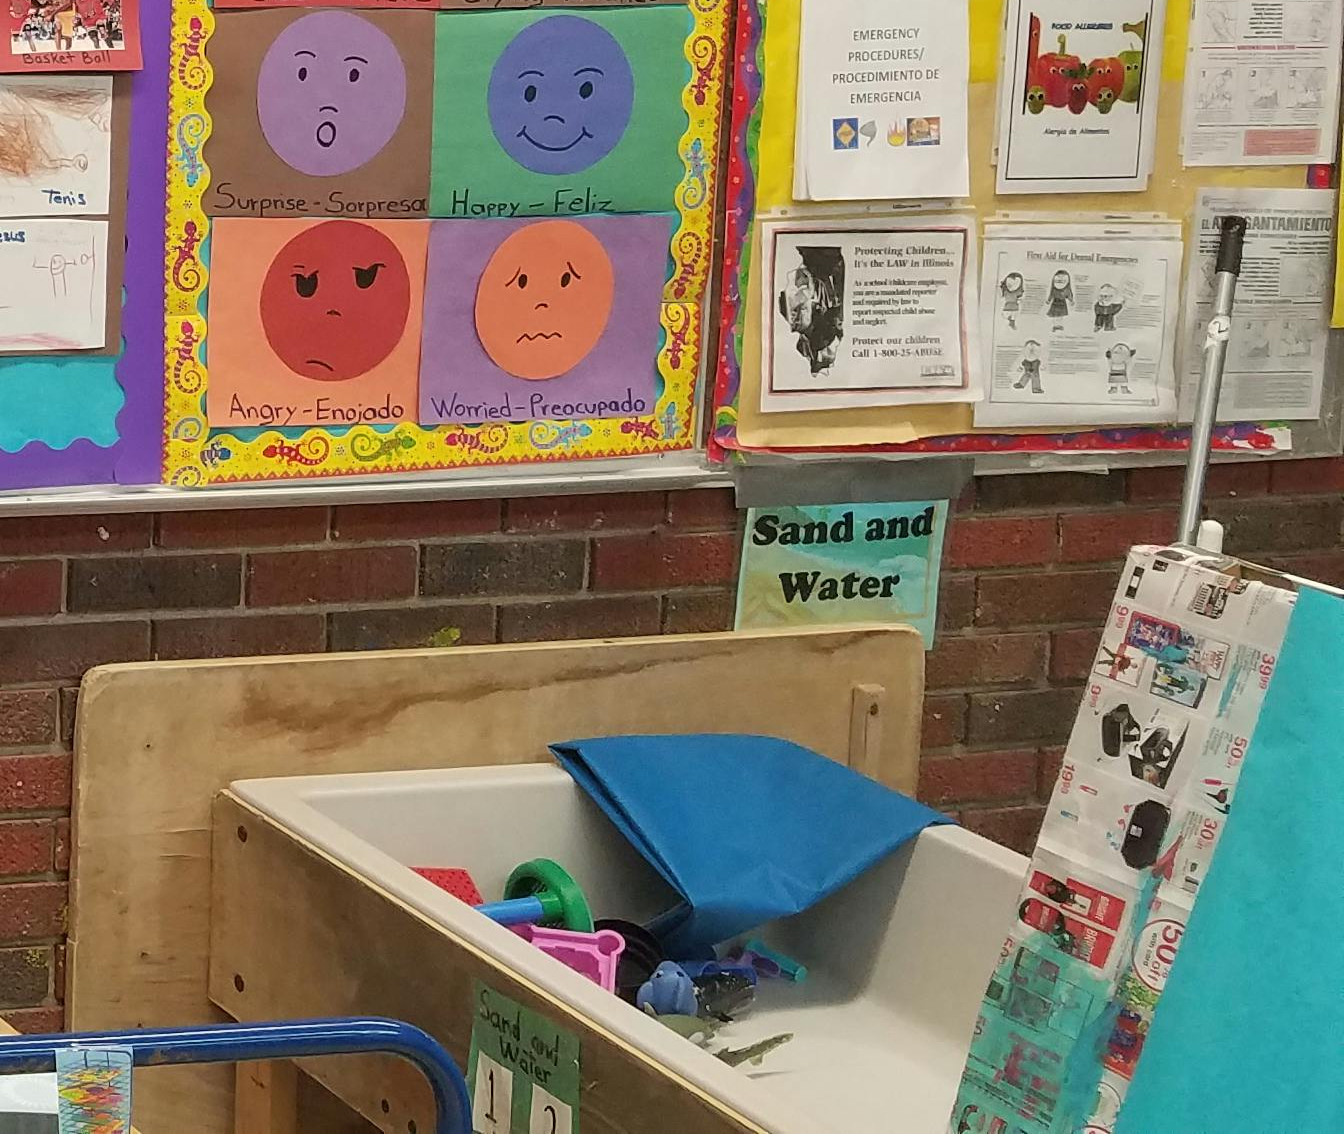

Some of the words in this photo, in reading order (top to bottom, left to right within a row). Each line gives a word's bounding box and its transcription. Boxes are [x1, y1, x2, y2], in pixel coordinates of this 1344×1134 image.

[852, 26, 921, 43] EMERGENCY
[22, 51, 76, 66] Basket
[82, 49, 112, 65] Ball
[847, 47, 925, 63] PROCEDURES/
[832, 68, 922, 85] PROCEDIMIENTO
[925, 68, 940, 81] DE
[849, 89, 922, 104] EMERGENCIA
[41, 188, 87, 207] Tenis
[450, 189, 521, 217] Happy
[553, 188, 616, 213] Feliz
[854, 246, 903, 257] Protecting
[854, 260, 868, 268] It's
[852, 337, 883, 345] Protect
[905, 336, 940, 344] children
[852, 348, 870, 358] Call
[751, 513, 856, 548] Sand
[864, 506, 934, 543] and
[778, 571, 902, 605] Water
[480, 989, 520, 1041] Sand
[531, 1035, 559, 1066] and
[485, 1068, 497, 1123] 1
